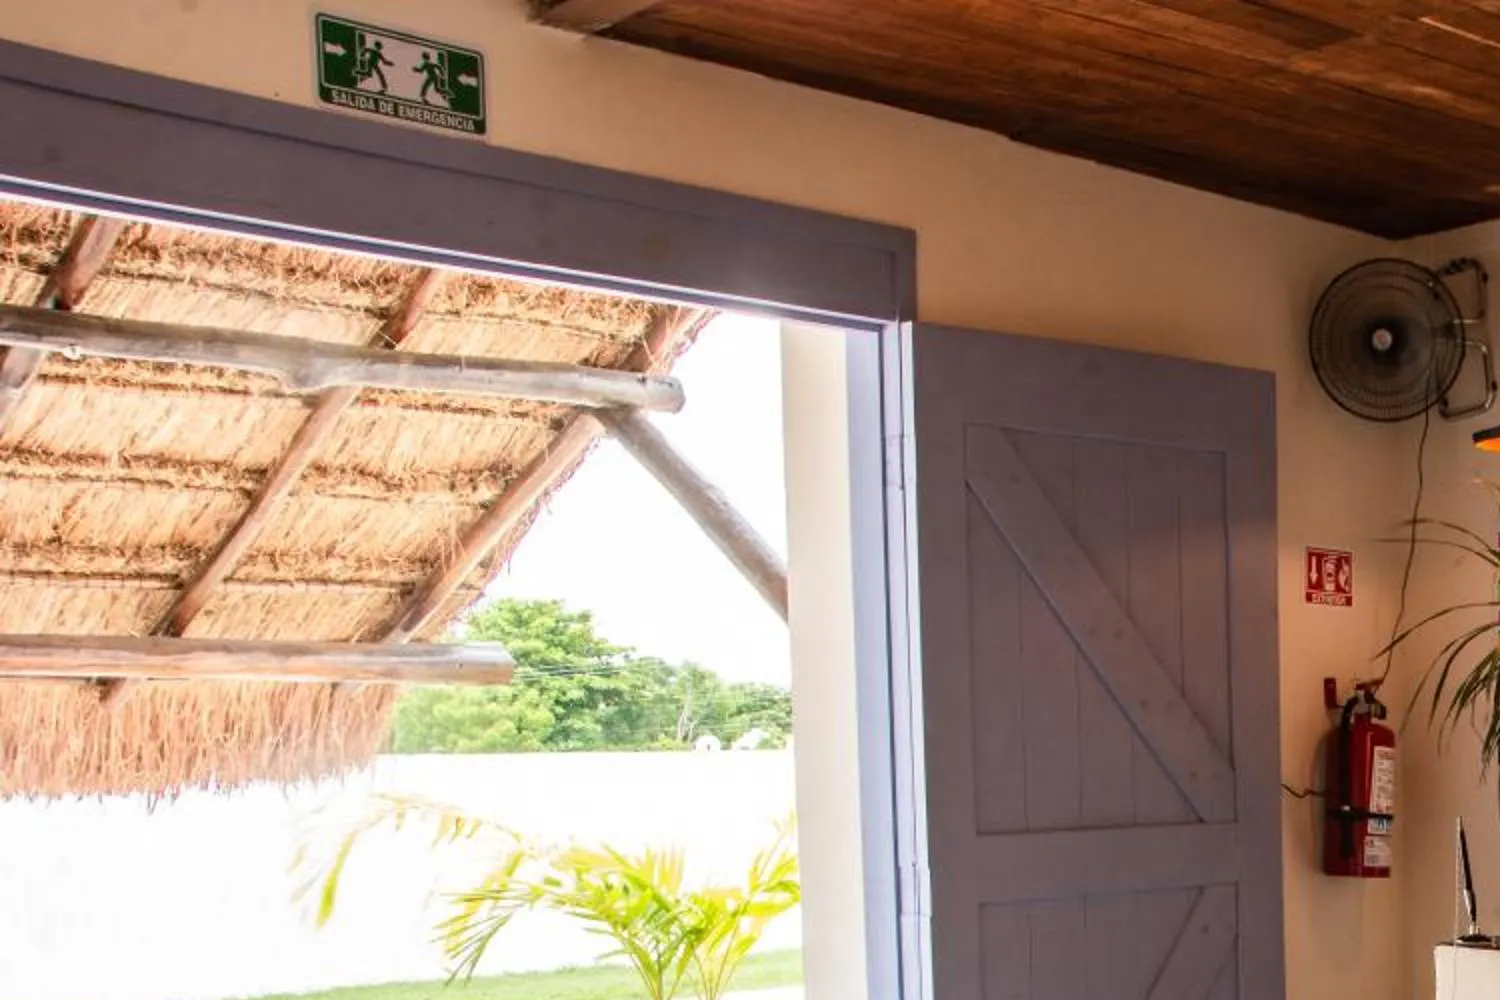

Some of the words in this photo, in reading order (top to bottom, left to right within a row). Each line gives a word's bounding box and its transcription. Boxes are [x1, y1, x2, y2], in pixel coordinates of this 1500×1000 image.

[331, 90, 376, 111] SALIDA
[379, 101, 395, 114] DE
[399, 105, 475, 131] EMERGENCIA
